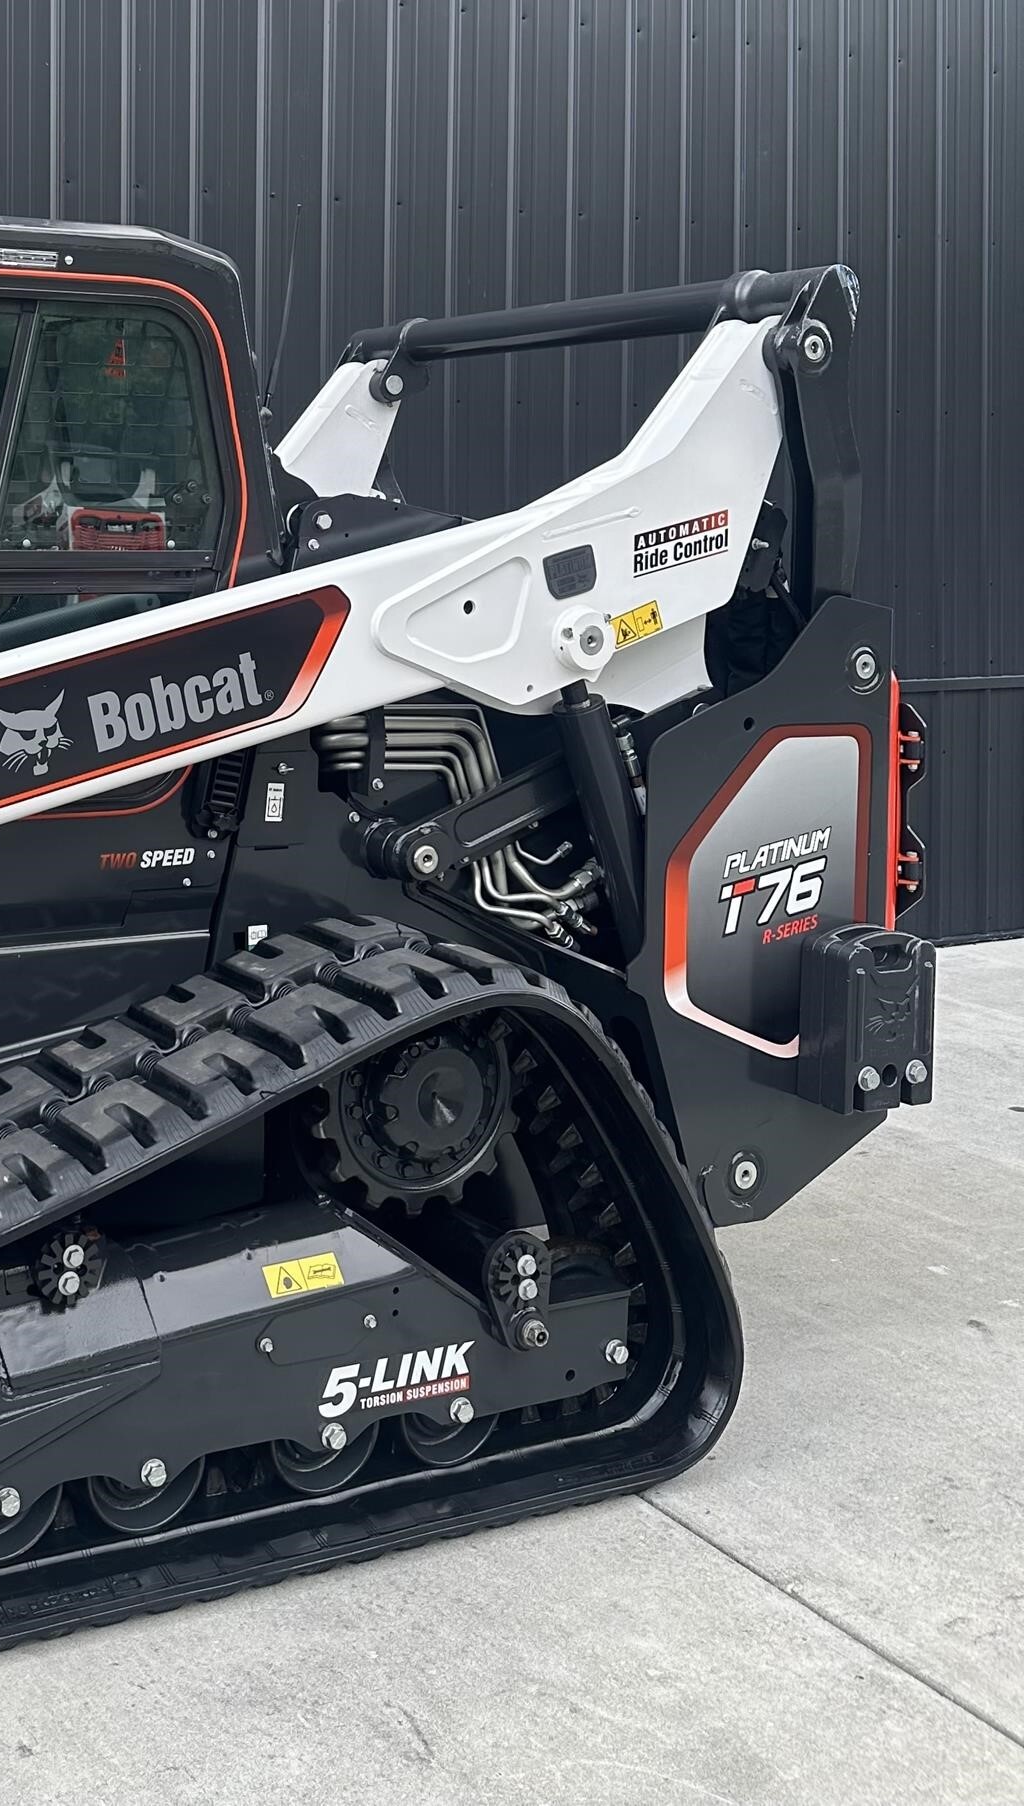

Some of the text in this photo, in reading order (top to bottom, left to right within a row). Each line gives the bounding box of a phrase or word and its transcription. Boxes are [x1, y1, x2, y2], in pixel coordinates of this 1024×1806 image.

[633, 528, 729, 574] Ride Control
[636, 512, 727, 549] AUTOMATIC
[87, 652, 263, 753] Bobcat
[100, 848, 196, 870] TWO SPEED
[723, 825, 832, 879] PLATINUM
[718, 855, 827, 937] T76
[762, 914, 819, 944] R-SERIES
[318, 1340, 475, 1418] 5-LINK
[360, 1377, 468, 1410] TORSION SUSPENSION
